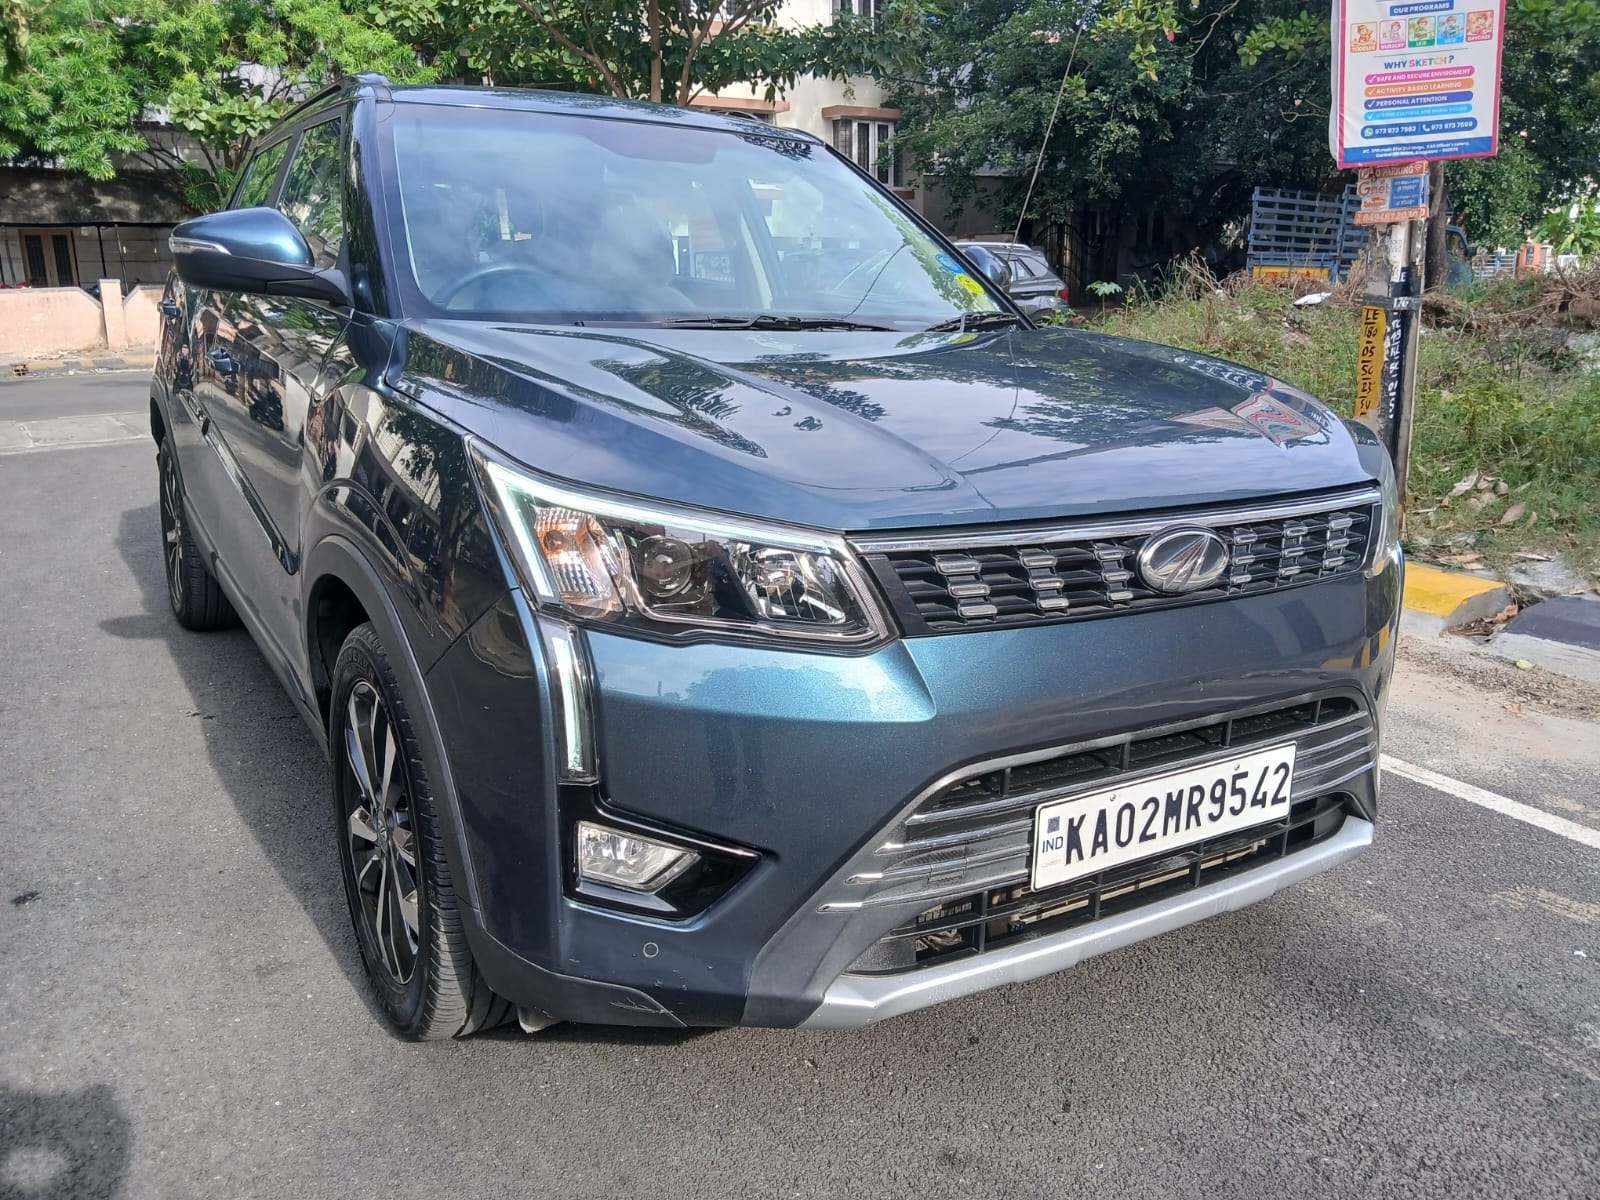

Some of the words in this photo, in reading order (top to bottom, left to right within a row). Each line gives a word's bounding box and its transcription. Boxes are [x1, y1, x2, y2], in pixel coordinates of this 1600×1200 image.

[1393, 6, 1408, 14] OUR
[1409, 2, 1450, 12] PROGRAMS
[1384, 60, 1407, 70] WHY
[1376, 75, 1392, 83] SAFE
[1392, 73, 1406, 81] AND
[1406, 71, 1430, 80] SECURE
[1376, 86, 1407, 95] ACTIVITY
[1408, 84, 1429, 92] BASED
[1429, 81, 1462, 91] LEARNING
[1376, 98, 1410, 107] PERSONAL
[1411, 95, 1447, 105] ATTENTION
[1383, 165, 1414, 177] PARKING
[1366, 309, 1379, 320] LE
[1364, 326, 1378, 338] 180
[1064, 761, 1290, 866] KA02MR9542
[1042, 835, 1064, 854] IND
